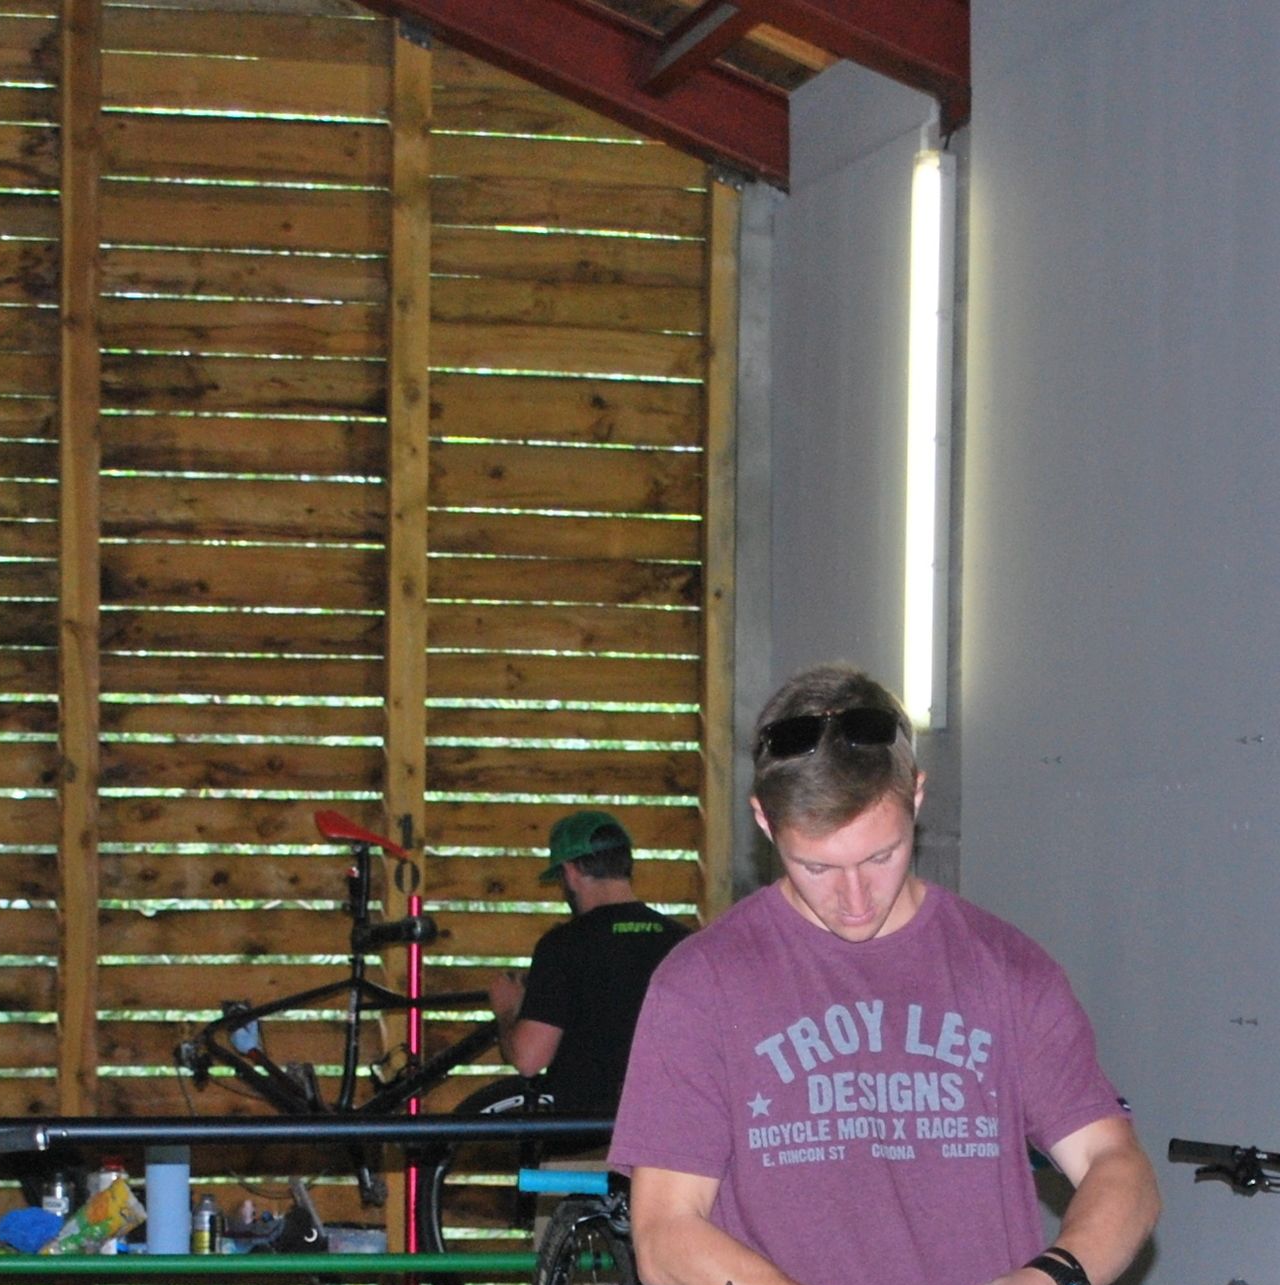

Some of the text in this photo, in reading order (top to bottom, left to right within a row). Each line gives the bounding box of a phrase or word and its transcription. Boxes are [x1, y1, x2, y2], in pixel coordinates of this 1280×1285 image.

[754, 999, 992, 1084] TROY LEE
[807, 1071, 965, 1114] DESIGNS
[748, 1119, 831, 1149] BICYCLE
[893, 1117, 906, 1140] X
[916, 1116, 969, 1139] RACE
[762, 1153, 775, 1168] E.
[779, 1147, 825, 1165] RINCON
[829, 1145, 846, 1161] ST
